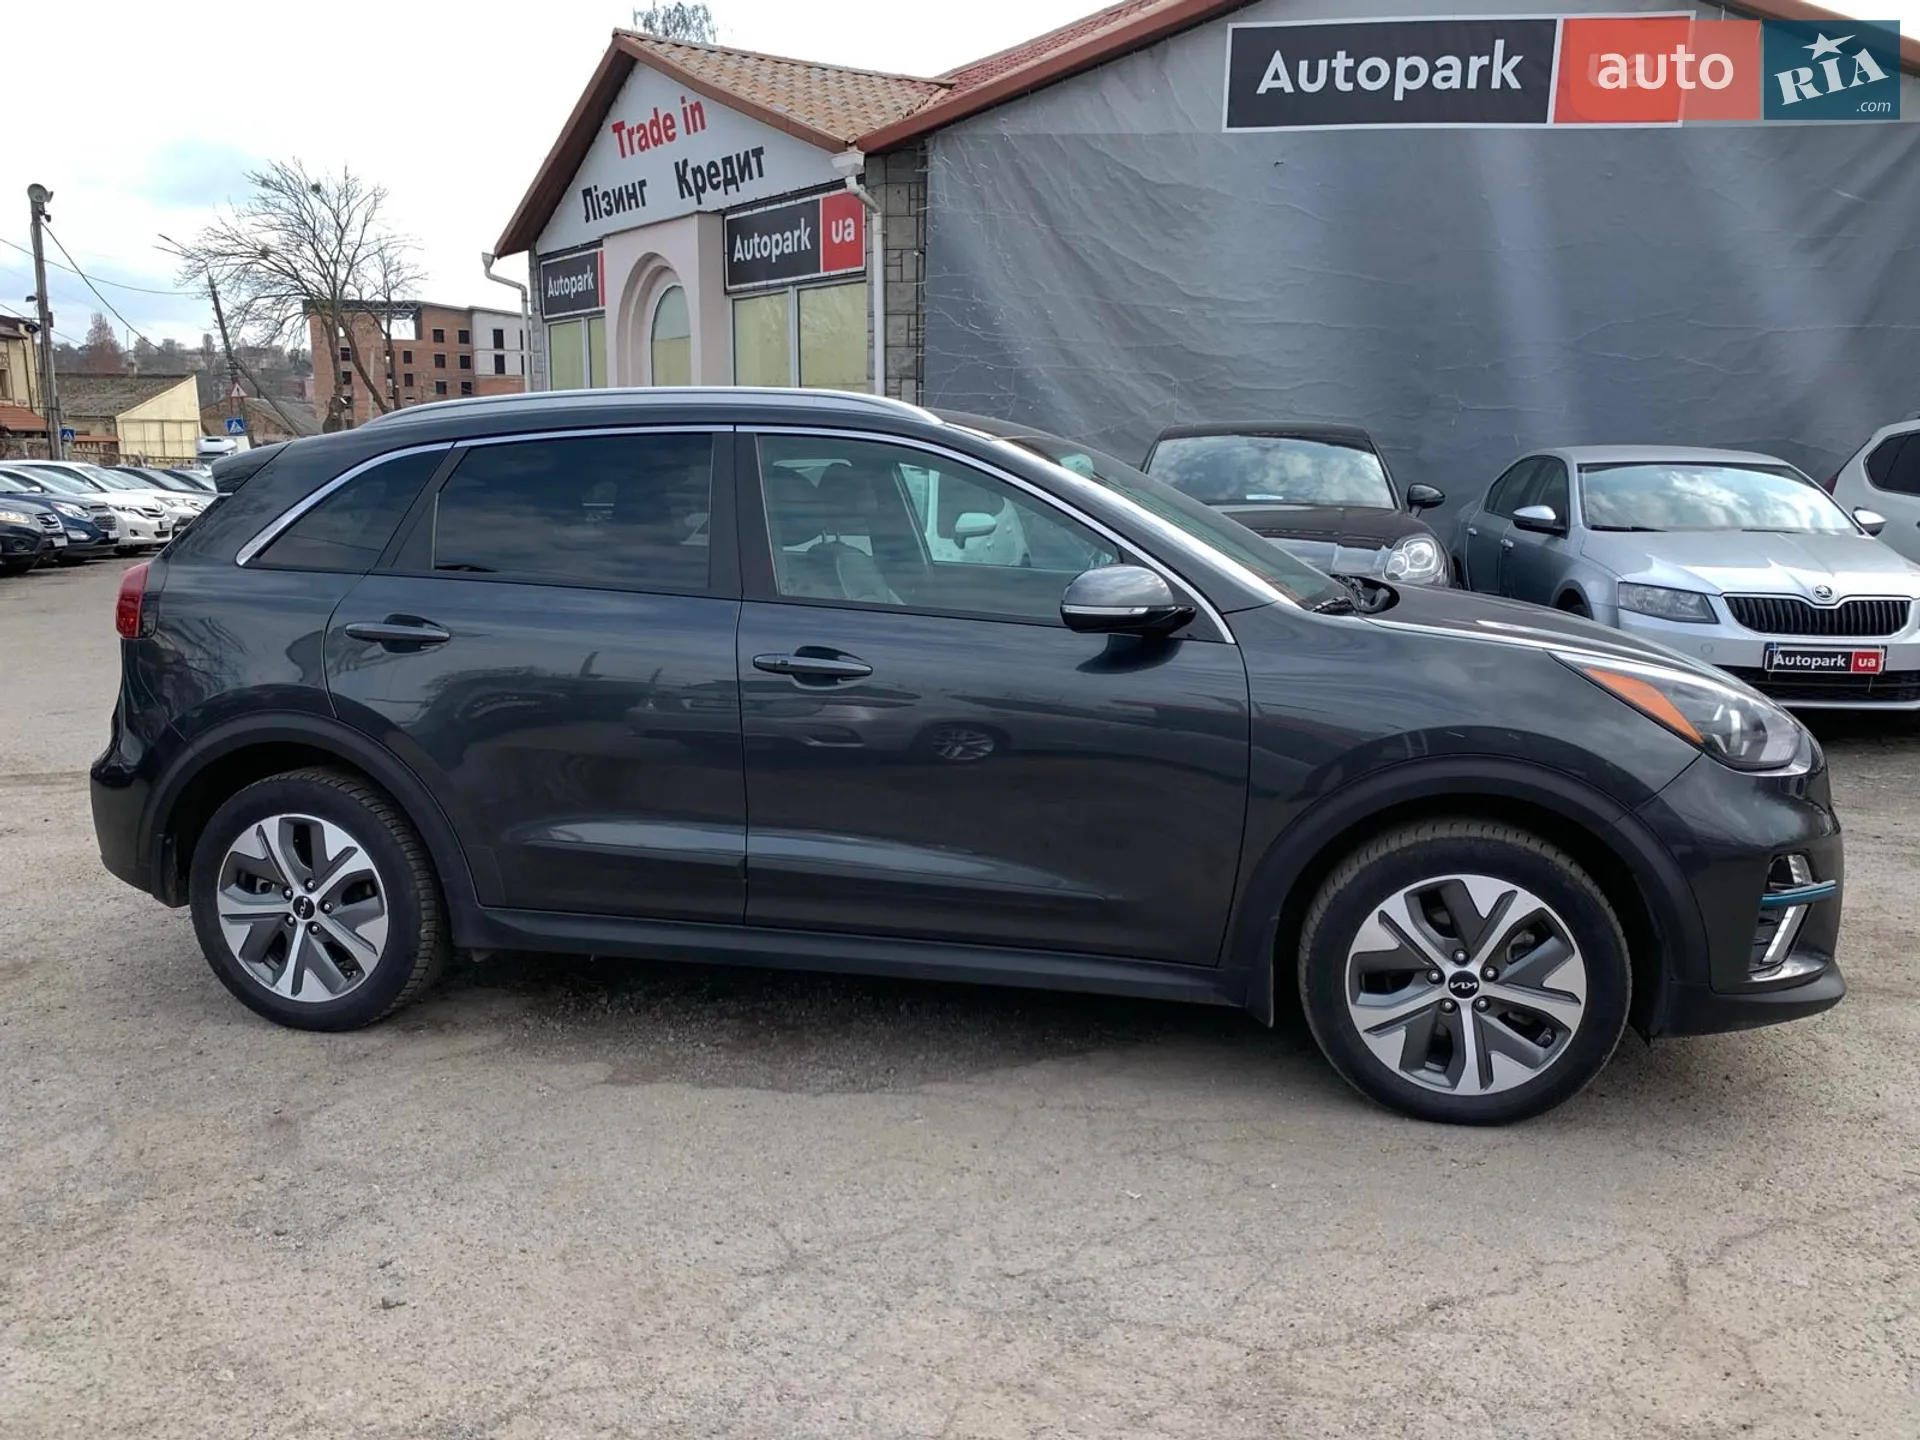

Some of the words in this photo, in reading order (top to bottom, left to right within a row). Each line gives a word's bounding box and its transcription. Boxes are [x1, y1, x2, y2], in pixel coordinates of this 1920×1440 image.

[1256, 39, 1524, 102] Autopark
[611, 107, 677, 159] Trade
[681, 96, 707, 136] in
[581, 179, 648, 224] Лізинг
[674, 147, 764, 204] Кредит
[733, 218, 811, 266] Autopark
[831, 215, 856, 244] ua
[547, 265, 595, 299] Autopark
[1775, 655, 1846, 669] Autopark
[1858, 657, 1876, 668] ua
